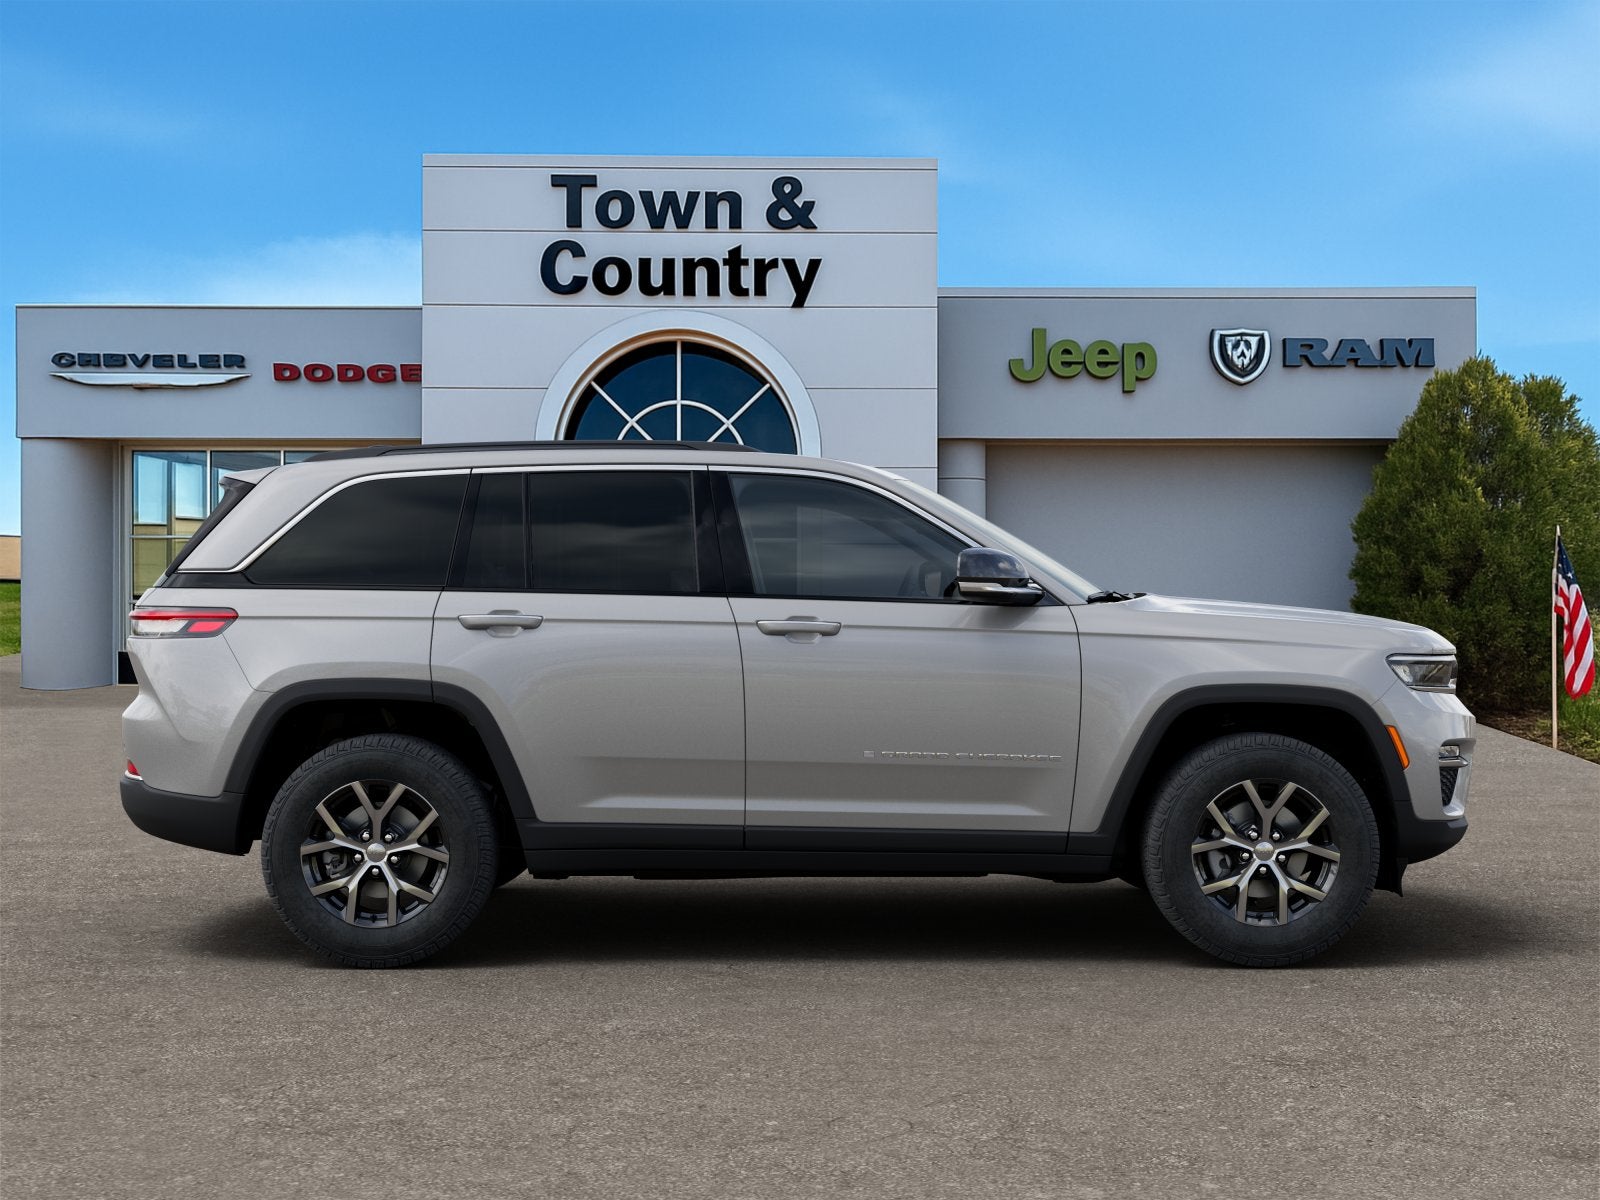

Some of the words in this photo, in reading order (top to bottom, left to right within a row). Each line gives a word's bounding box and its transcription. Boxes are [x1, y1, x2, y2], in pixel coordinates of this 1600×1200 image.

[550, 173, 743, 230] Town
[765, 175, 818, 230] &
[539, 239, 823, 309] Country
[272, 362, 422, 384] DODGE
[1008, 327, 1158, 393] Jeep
[1282, 337, 1436, 368] RAM
